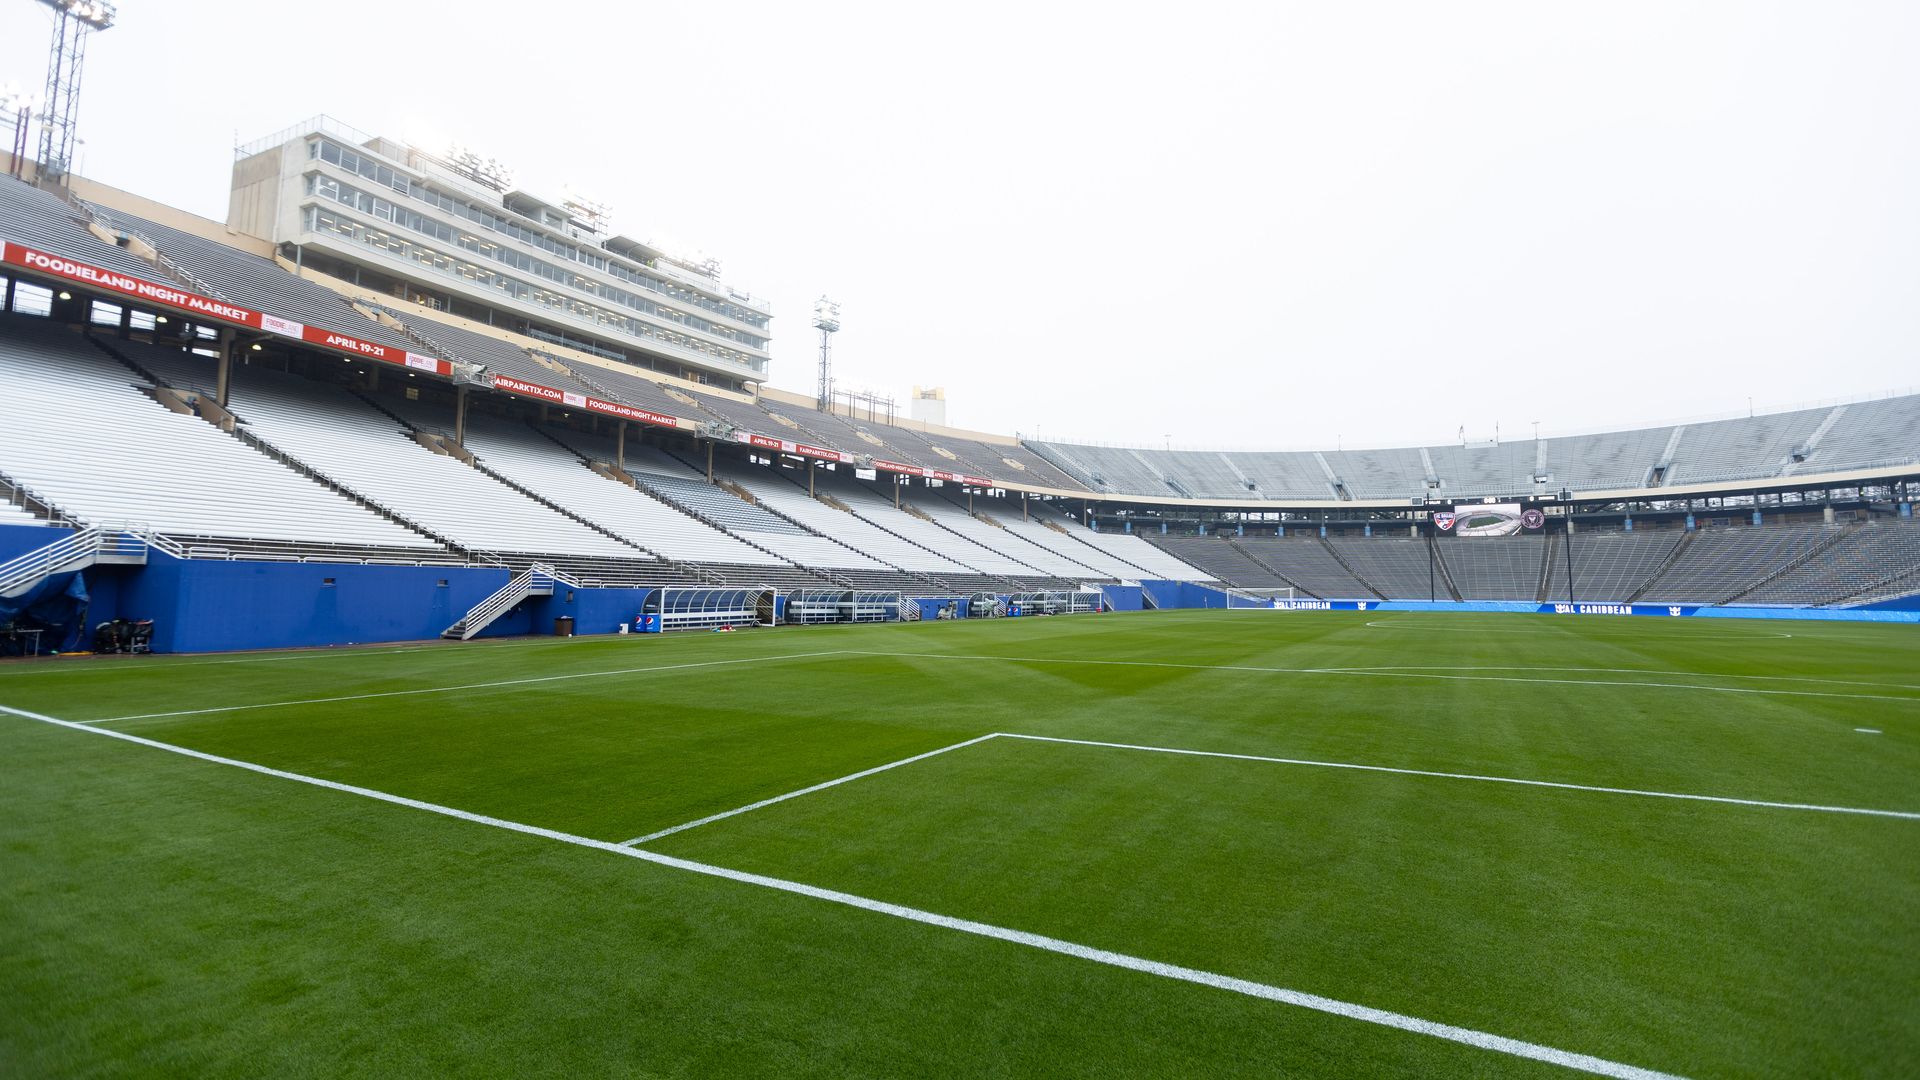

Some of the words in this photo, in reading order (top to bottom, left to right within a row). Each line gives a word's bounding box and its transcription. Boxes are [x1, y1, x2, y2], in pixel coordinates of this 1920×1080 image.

[25, 252, 136, 290] FOODIELAND
[138, 284, 188, 305] NIGHT
[188, 298, 249, 321] MARKET
[326, 335, 358, 350] APRIL
[360, 343, 385, 356] 19-21
[589, 400, 631, 416] FOODIELAND
[632, 409, 650, 420] NIGHT
[651, 415, 676, 426] MARKET
[1579, 605, 1632, 615] CARIBBEAN
